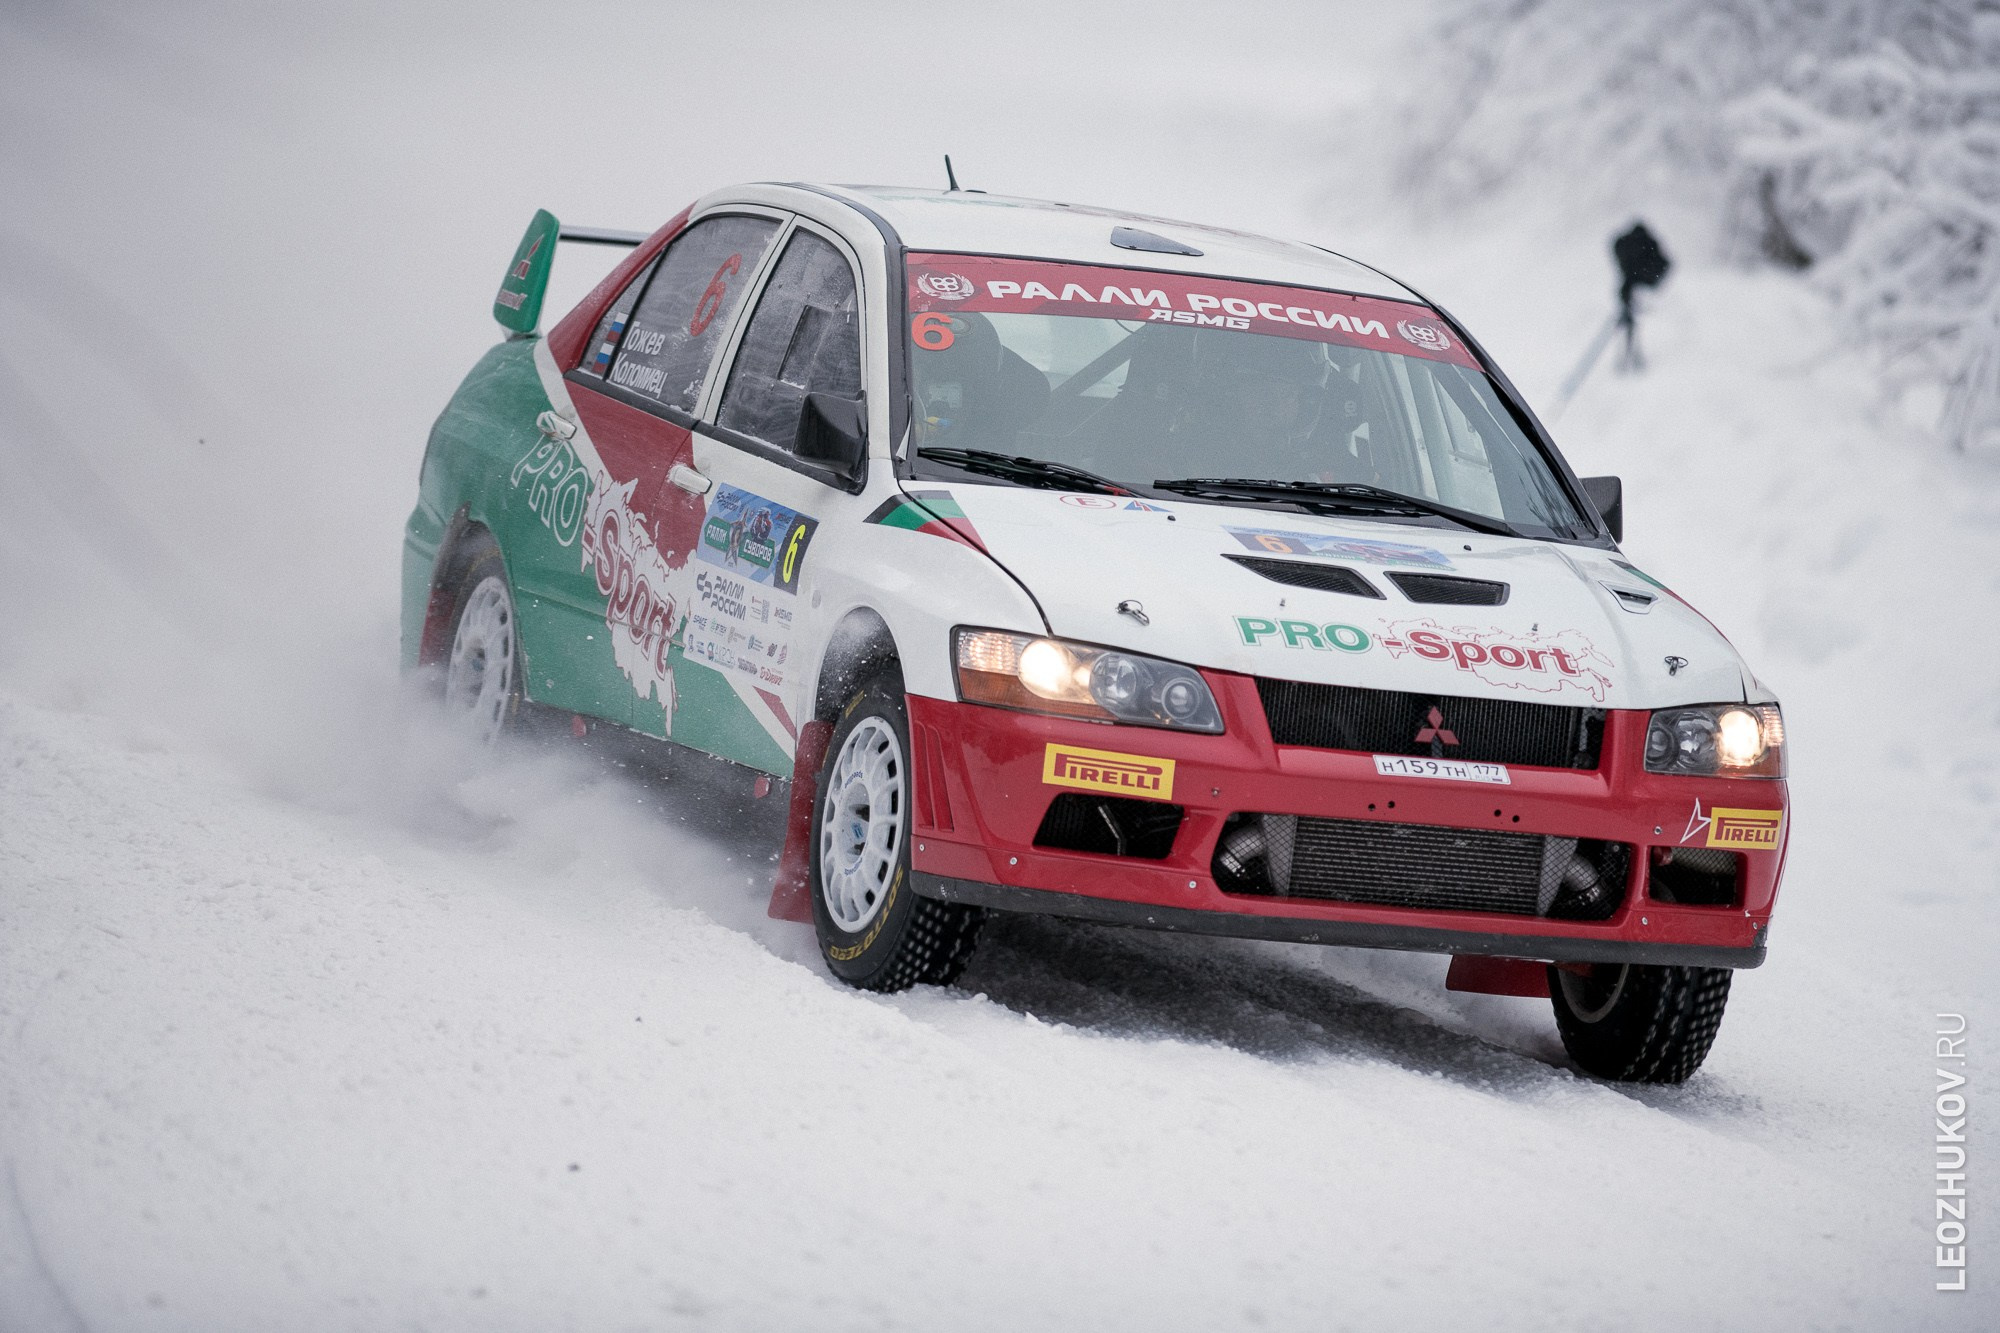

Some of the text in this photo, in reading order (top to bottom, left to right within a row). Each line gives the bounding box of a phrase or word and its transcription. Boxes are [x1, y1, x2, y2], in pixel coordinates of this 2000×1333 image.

[690, 253, 742, 337] 6
[986, 280, 1391, 339] РАЛЛИ РОССИИ
[911, 311, 954, 351] 6
[1148, 308, 1251, 330] ASMG
[622, 320, 666, 356] Гожев
[608, 352, 669, 399] Коломиец
[783, 524, 806, 584] 6
[1254, 535, 1293, 554] 6
[713, 575, 745, 600] РАЛЛИ
[710, 594, 747, 621] РОССИИ
[1053, 752, 1163, 791] PIRELLI
[1473, 765, 1500, 777] 177
[1714, 816, 1779, 843] PIRELLI
